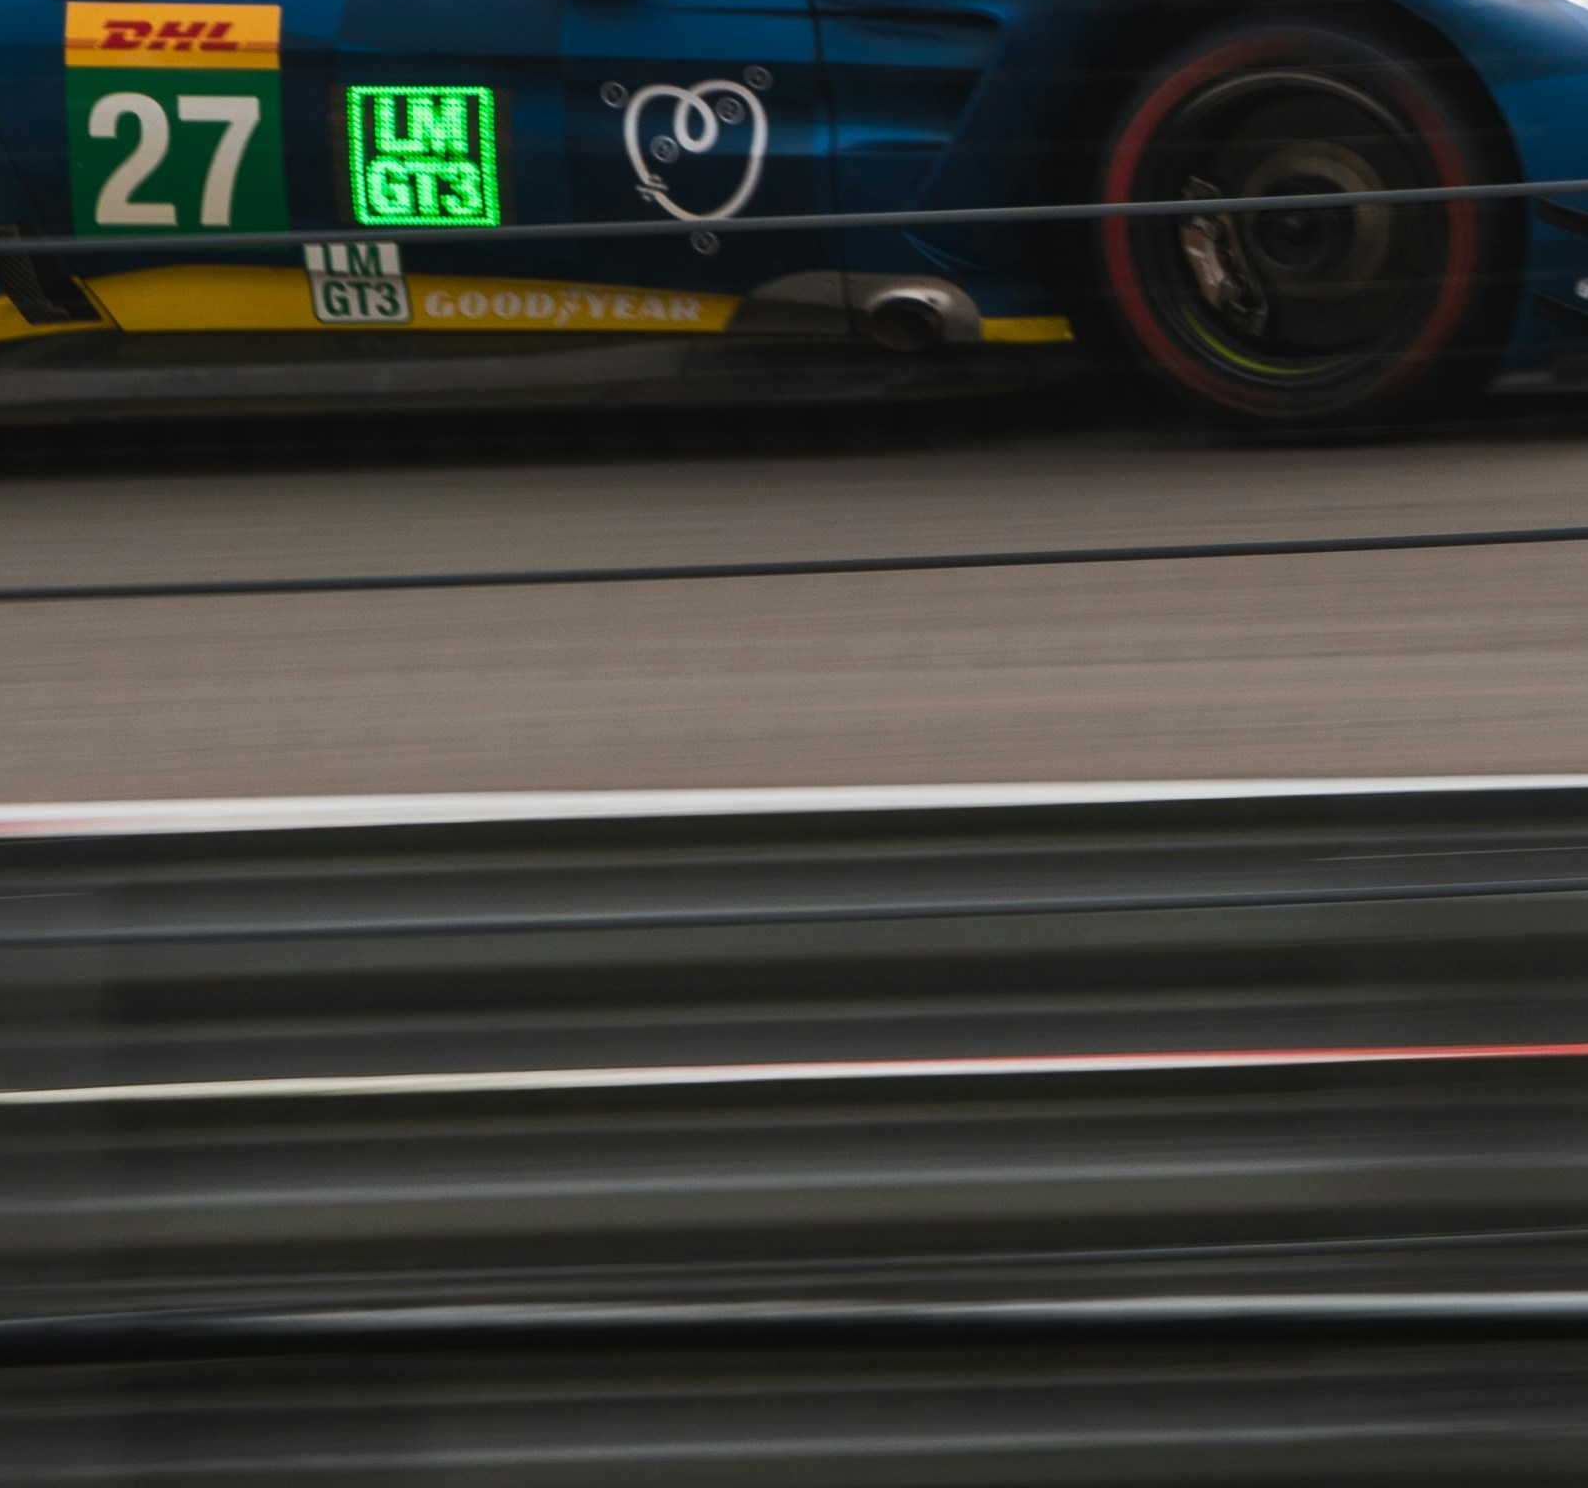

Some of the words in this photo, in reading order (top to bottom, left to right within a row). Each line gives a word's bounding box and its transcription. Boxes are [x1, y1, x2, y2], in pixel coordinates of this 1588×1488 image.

[100, 20, 240, 52] DHL
[374, 95, 469, 154] LM
[88, 91, 261, 227] 27
[366, 156, 483, 217] GT3
[321, 243, 383, 277] LM
[322, 280, 402, 320] GT3
